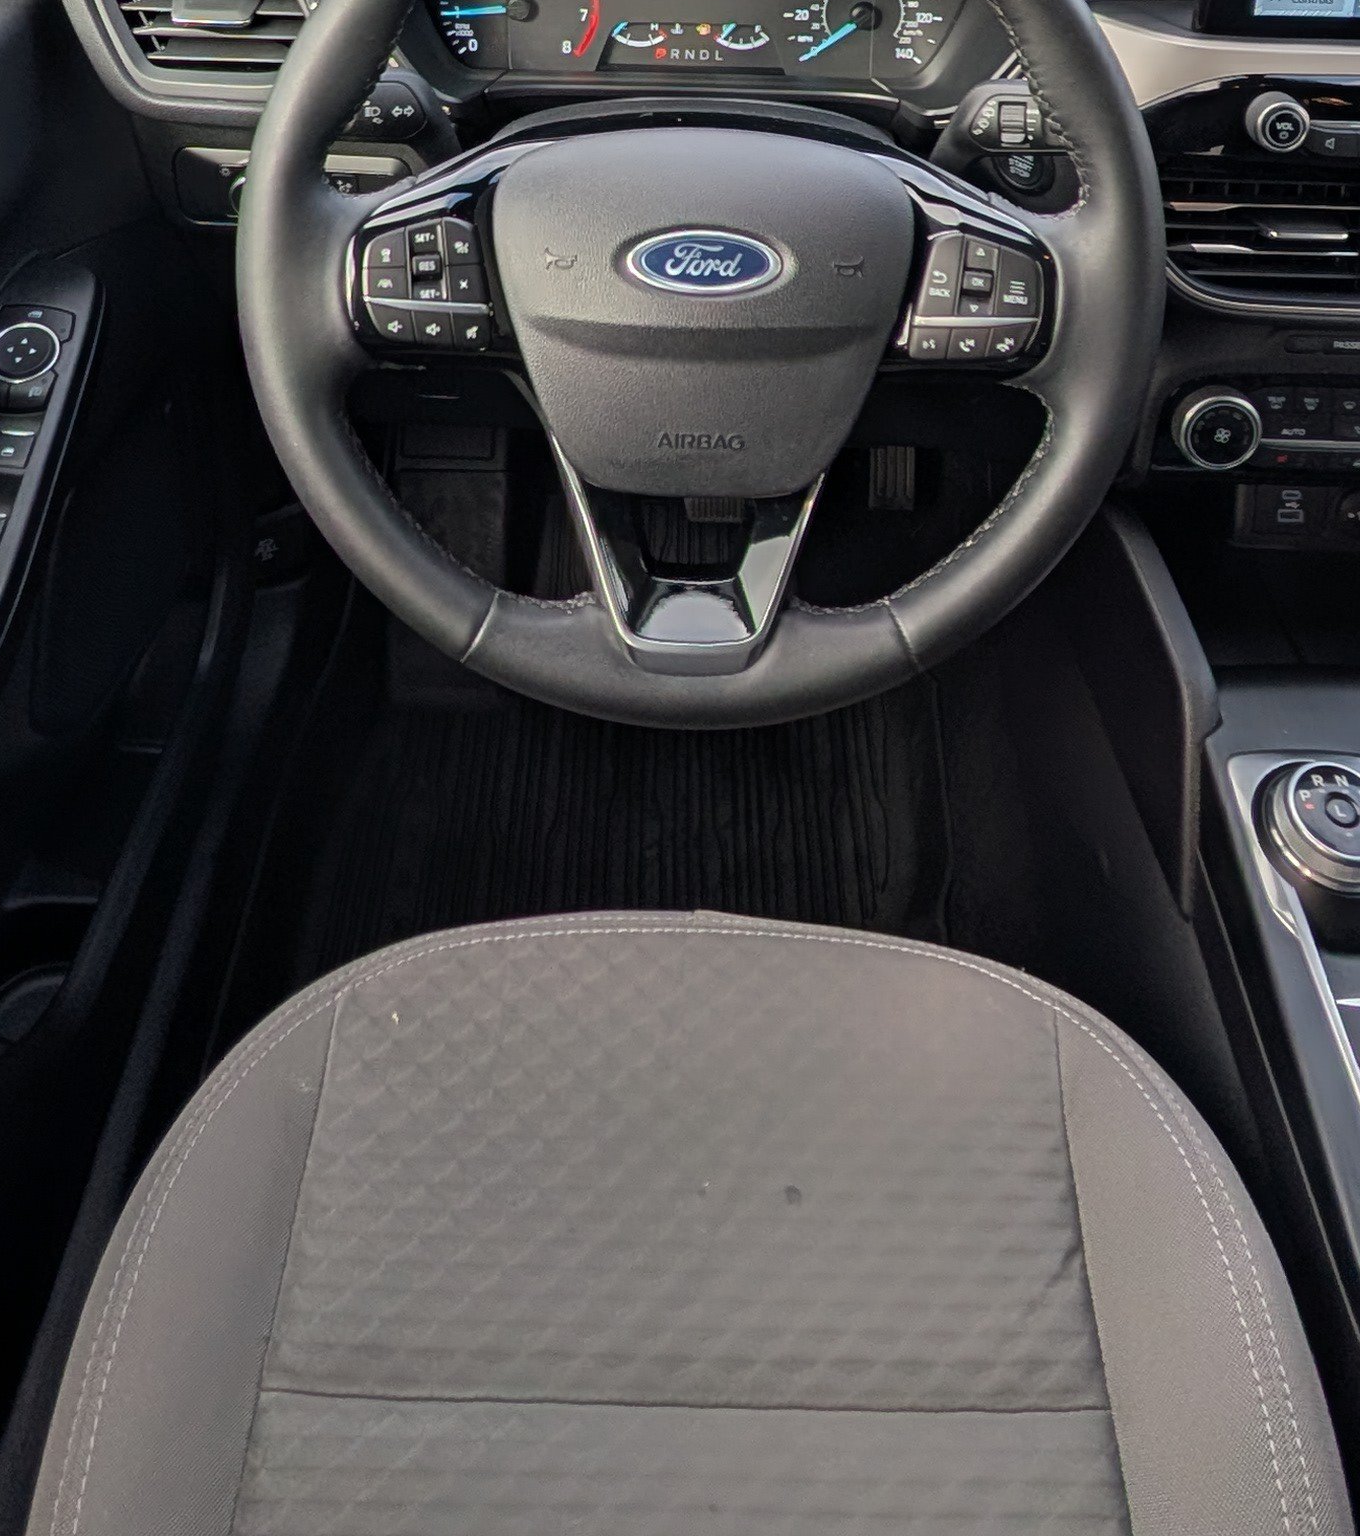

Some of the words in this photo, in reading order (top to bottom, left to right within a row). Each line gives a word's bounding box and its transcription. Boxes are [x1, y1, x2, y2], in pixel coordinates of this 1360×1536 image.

[580, 8, 588, 22] 7
[794, 9, 809, 21] 20
[916, 12, 933, 23] 120
[468, 38, 478, 52] 0
[562, 40, 571, 54] 8
[670, 49, 679, 59] R
[685, 49, 695, 60] N
[700, 50, 709, 60] D
[715, 50, 723, 61] L
[895, 48, 914, 59] 140
[1276, 122, 1294, 131] VOL
[665, 243, 742, 277] Ford
[928, 287, 951, 297] BACK
[1003, 295, 1028, 305] MENU
[658, 432, 746, 451] AIRBAG
[1310, 774, 1325, 786] R
[1333, 774, 1349, 788] N
[1298, 789, 1312, 801] P
[1334, 805, 1346, 817] L
